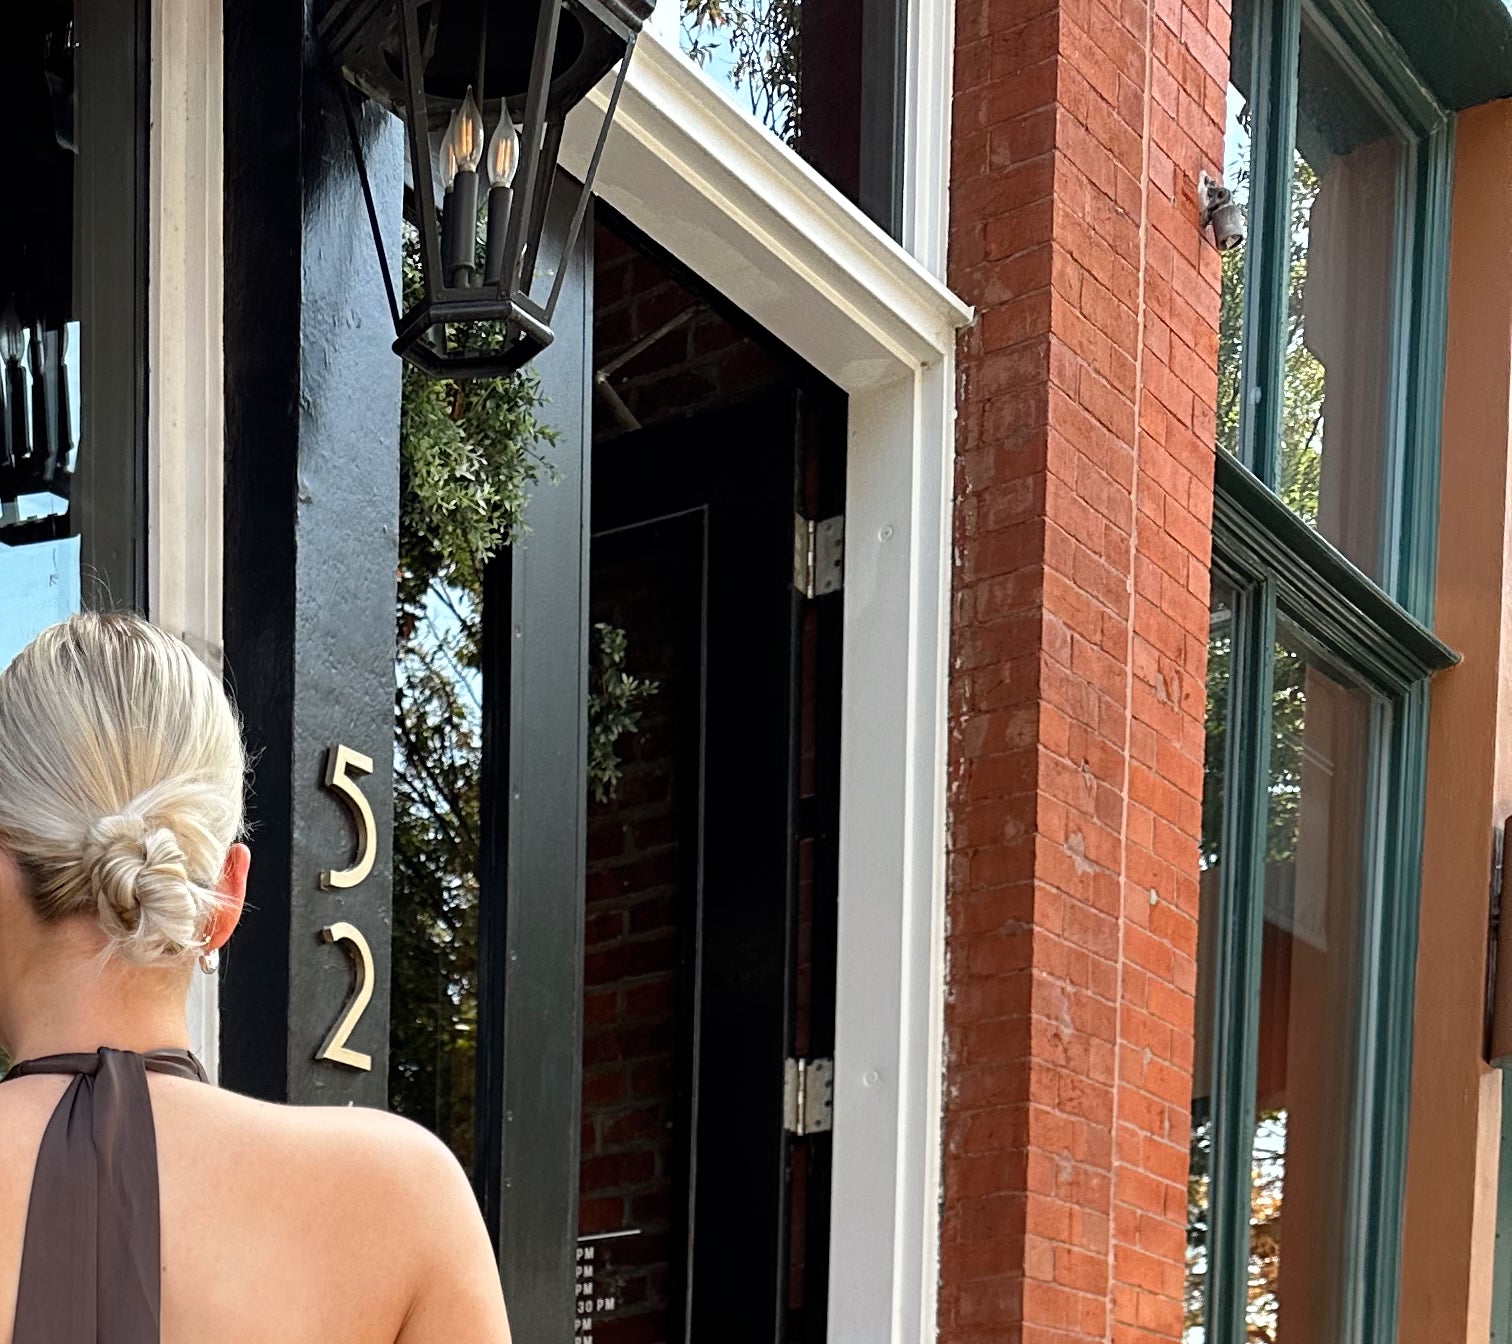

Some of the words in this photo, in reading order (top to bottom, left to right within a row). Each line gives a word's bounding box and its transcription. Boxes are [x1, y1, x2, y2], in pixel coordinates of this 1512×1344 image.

[575, 1246, 595, 1261] PM
[575, 1264, 593, 1279] PM
[574, 1281, 593, 1296] PM
[577, 1299, 593, 1314] 30
[596, 1297, 615, 1312] PM
[574, 1317, 592, 1332] PM
